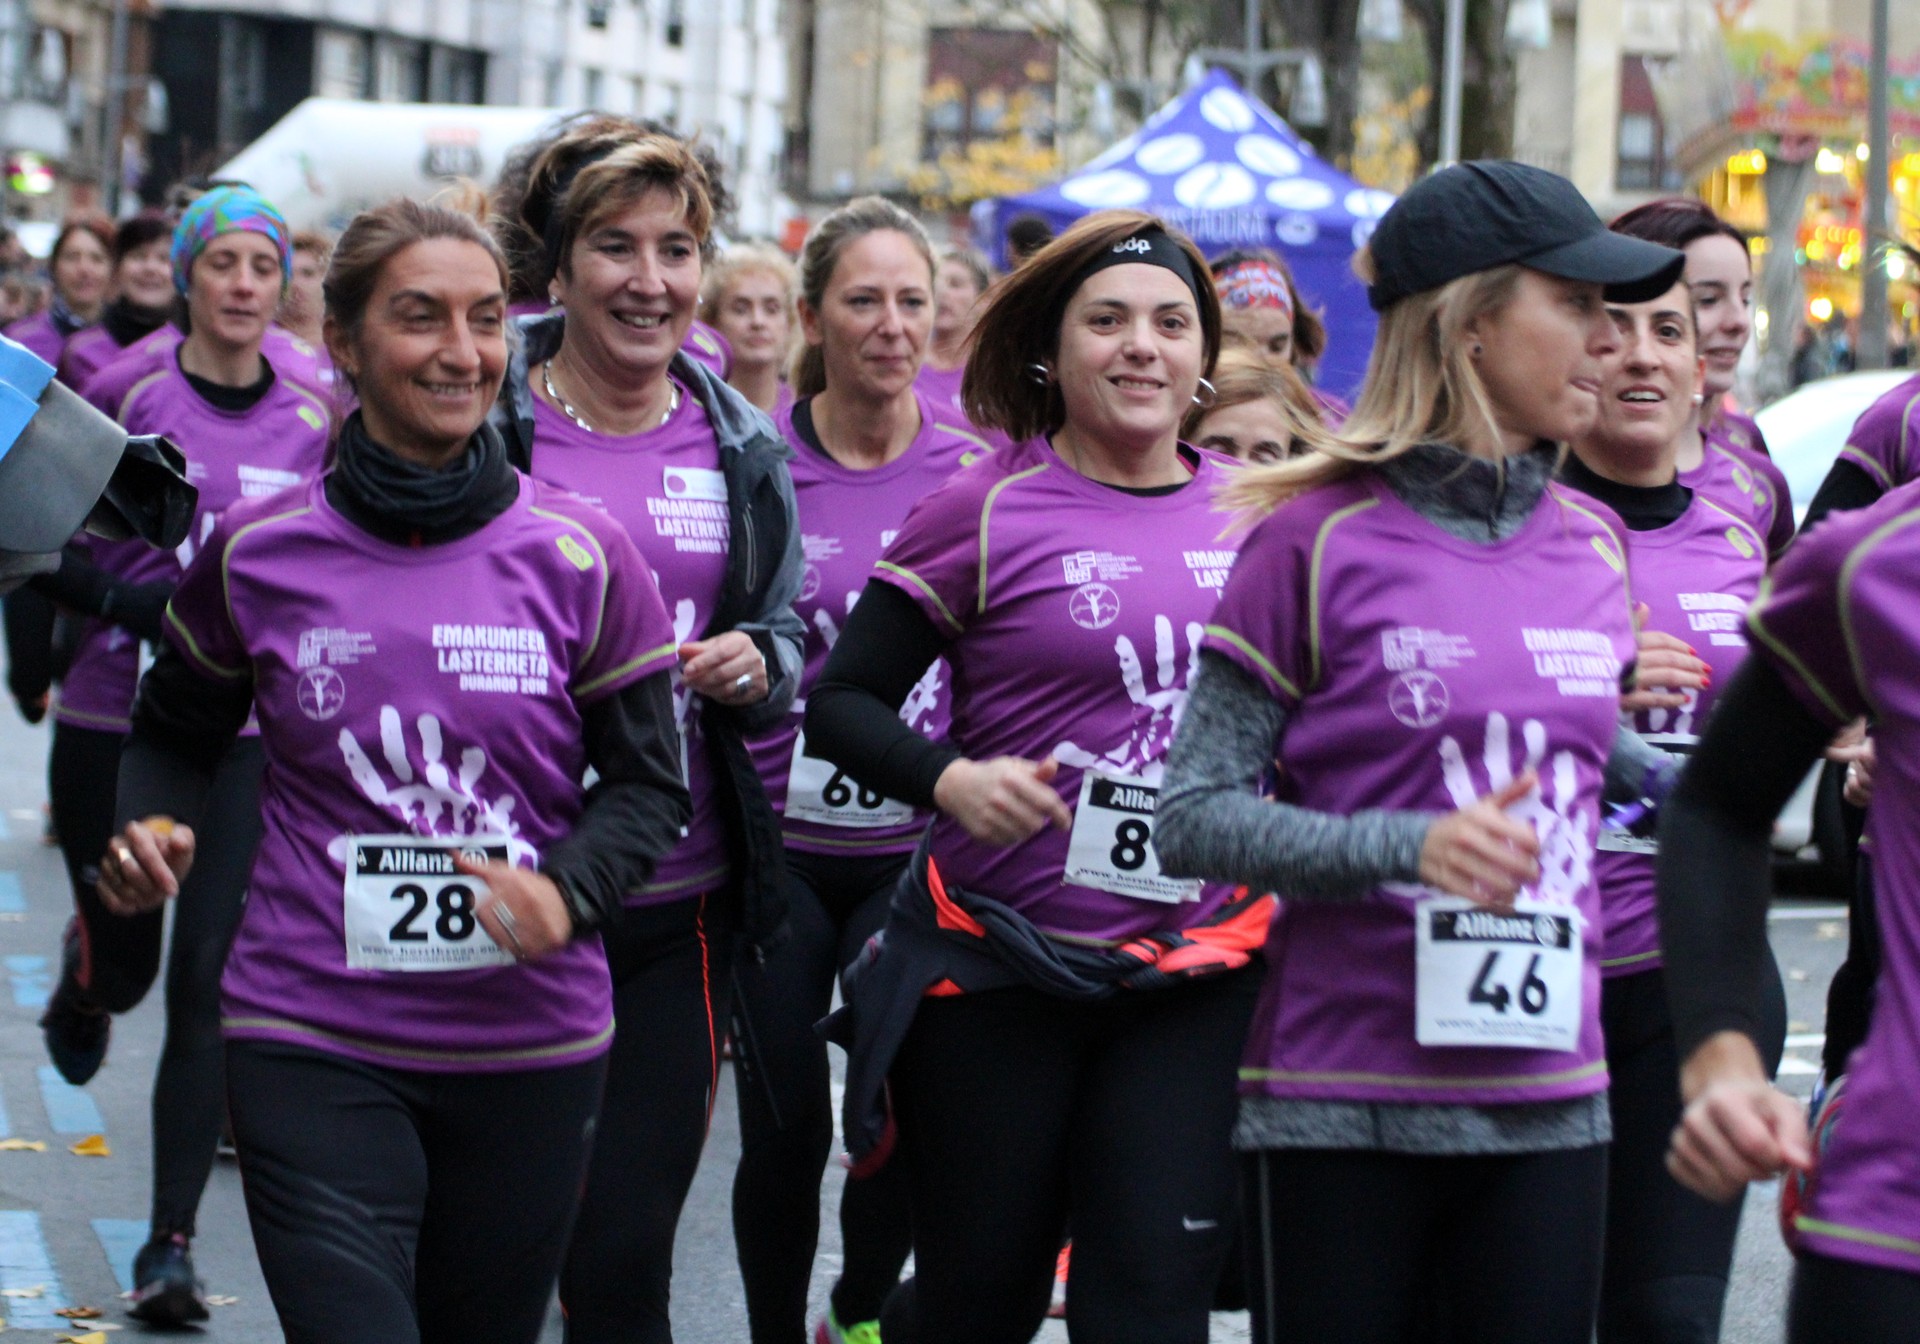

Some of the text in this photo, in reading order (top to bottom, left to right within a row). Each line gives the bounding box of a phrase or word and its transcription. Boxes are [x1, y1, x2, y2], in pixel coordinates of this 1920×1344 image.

[1182, 550, 1238, 568] EMAKU
[432, 624, 546, 653] EMAKUMEEN
[438, 648, 548, 677] LASTERKETA
[460, 673, 518, 693] DURANGO
[1110, 786, 1157, 811] Allia
[1110, 819, 1150, 870] 8
[379, 848, 454, 872] Allianz
[389, 883, 475, 941] 28
[1469, 951, 1548, 1015] 46
